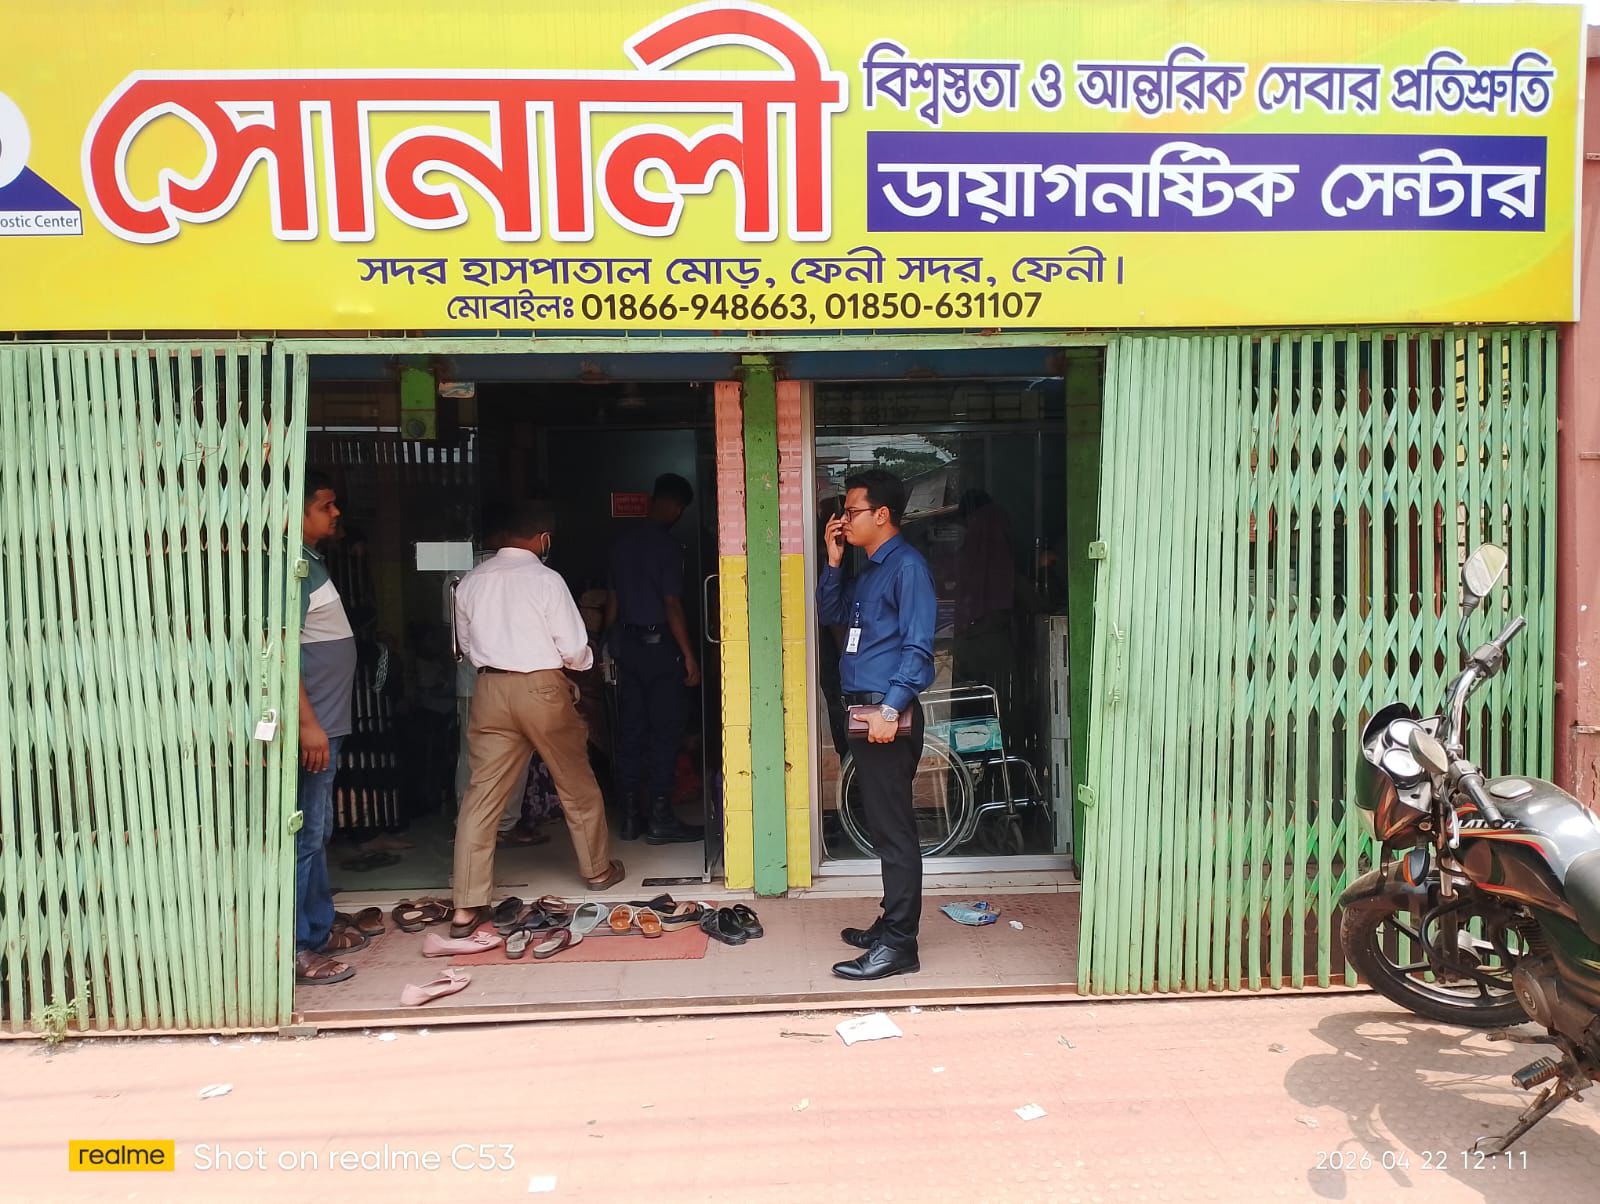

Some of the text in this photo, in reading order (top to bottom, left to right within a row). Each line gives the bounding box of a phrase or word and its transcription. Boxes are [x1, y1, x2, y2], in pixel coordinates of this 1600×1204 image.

[862, 42, 1554, 125] বিশ্বস্ততা ও আন্তরিক সেবার প্রতিশ্রুতি
[87, 6, 842, 238] সোনালী
[877, 141, 1541, 224] ডায়াগনষ্টিক সেন্টার
[34, 214, 79, 228] Center
[357, 258, 448, 285] সদর
[460, 258, 652, 287] হাসপাতাল
[666, 258, 776, 290] মোড়,
[790, 245, 887, 285] ফেনী
[896, 257, 997, 288] সদর,
[581, 293, 816, 324] 01866-948663,
[825, 291, 1042, 320] 01850-631107
